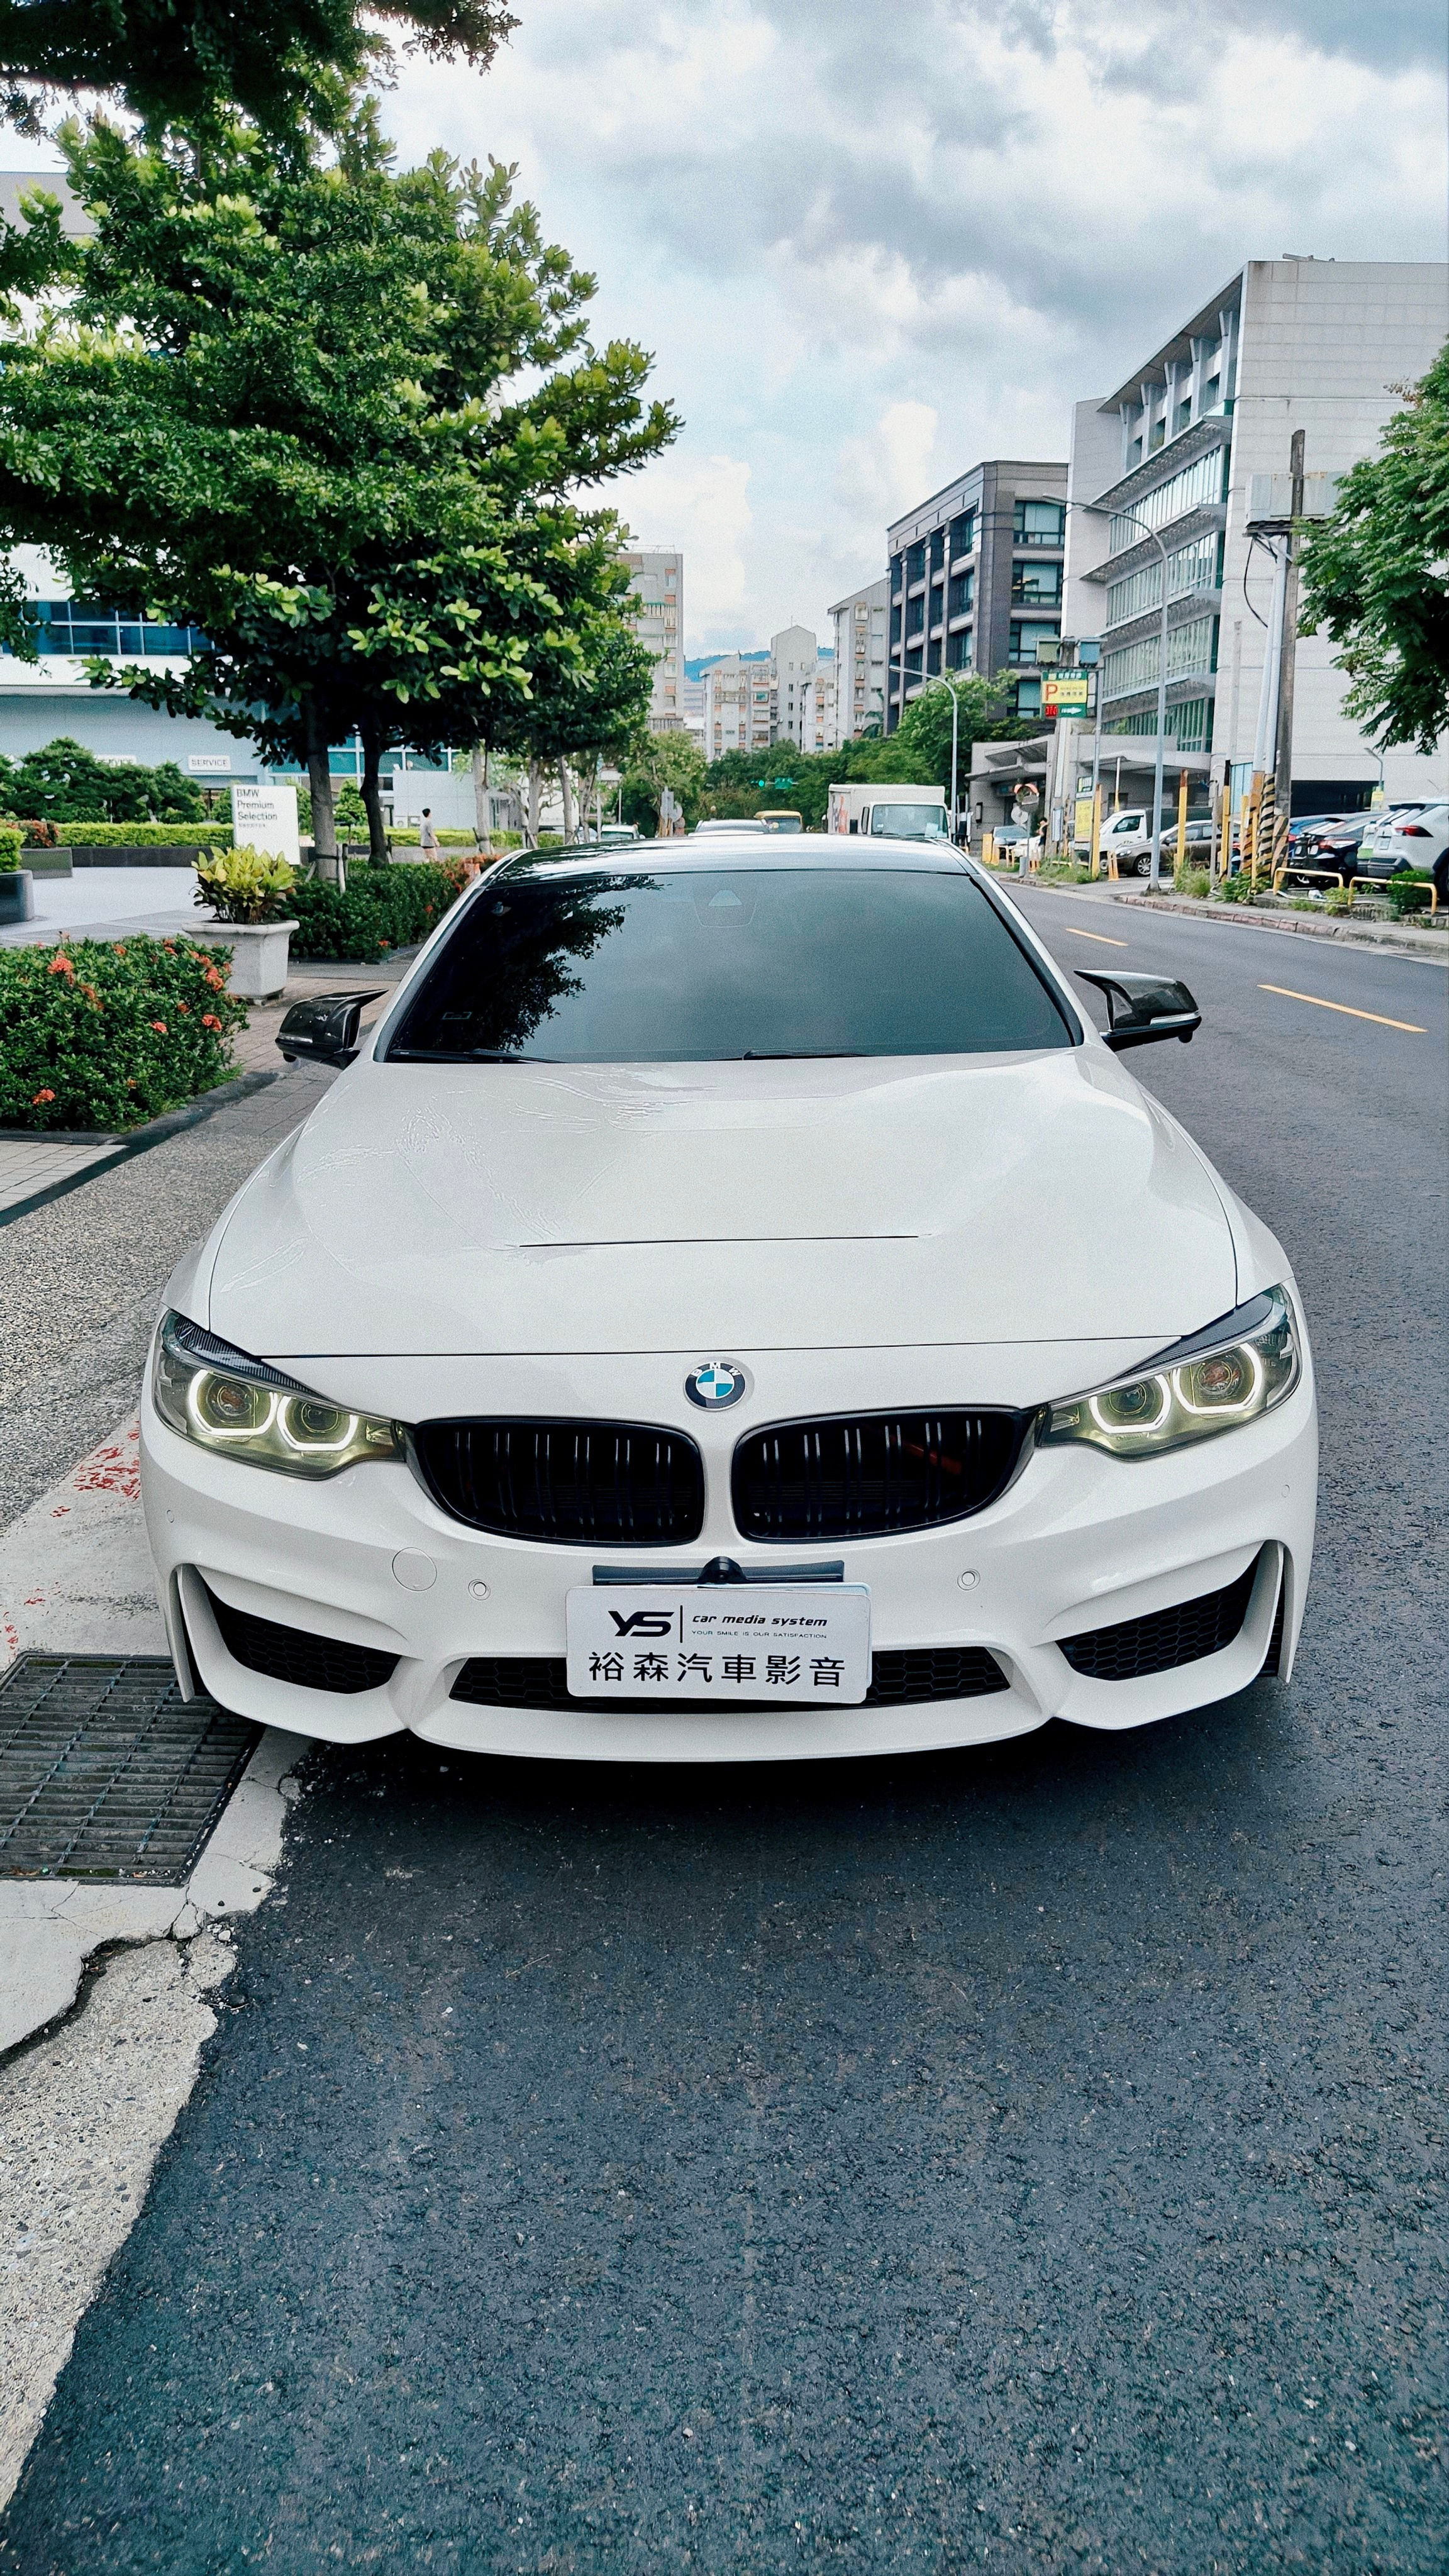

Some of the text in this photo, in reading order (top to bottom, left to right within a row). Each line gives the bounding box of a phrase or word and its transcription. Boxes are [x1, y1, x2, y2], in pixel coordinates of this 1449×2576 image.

[1046, 684, 1058, 701] P
[236, 789, 260, 797] BMW
[237, 800, 274, 809] Premium
[238, 811, 277, 820] Selection
[691, 1362, 741, 1377] BMW
[608, 1611, 675, 1637] YS
[722, 1615, 766, 1624] media
[771, 1616, 828, 1626] system
[589, 1652, 845, 1687] 裕森汽車影音
